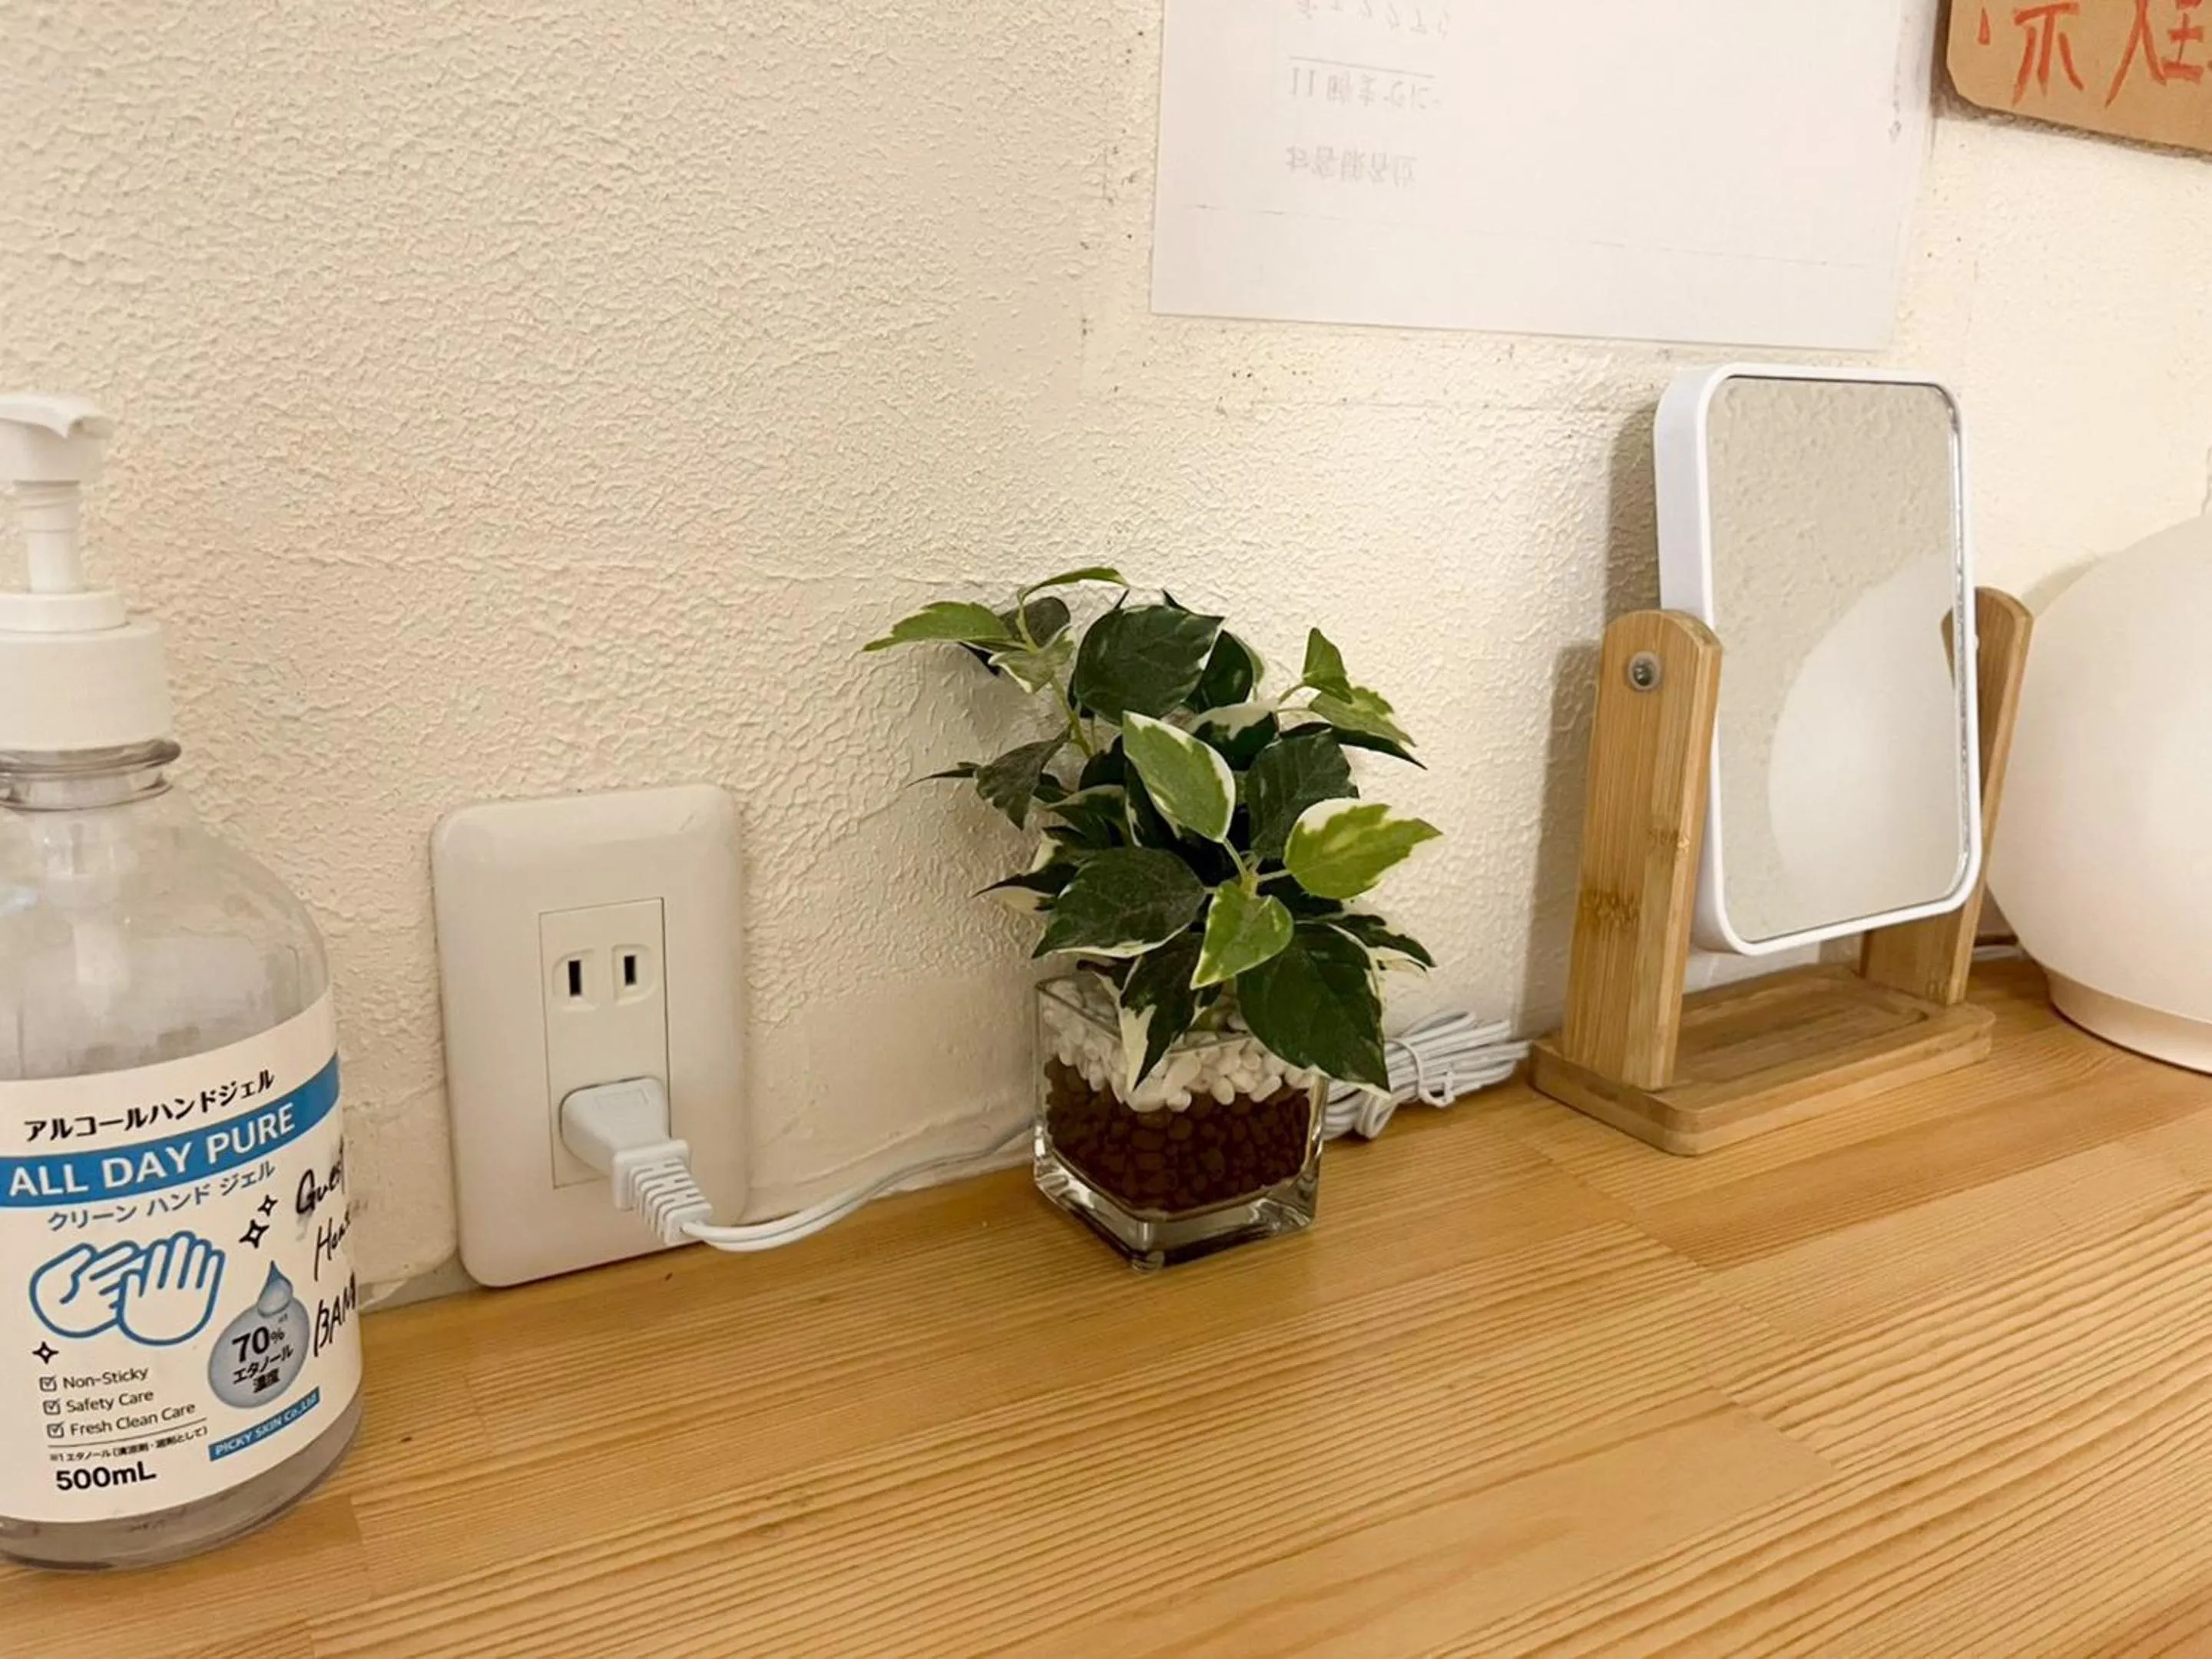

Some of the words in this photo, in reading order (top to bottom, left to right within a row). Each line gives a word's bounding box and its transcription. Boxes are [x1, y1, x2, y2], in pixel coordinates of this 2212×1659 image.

[24, 1069, 275, 1141] アルコールハンドジェル
[9, 1164, 89, 1197] ALL
[101, 1141, 193, 1189] DAY
[206, 1102, 296, 1165] PURE
[47, 1205, 137, 1231] クリーン
[147, 1183, 211, 1217] ハンド
[219, 1160, 276, 1197] ジェル
[232, 1326, 286, 1363] 70%
[63, 1367, 149, 1389] Non-Sticky
[233, 1344, 294, 1384] エタノール
[66, 1398, 114, 1413] Safety
[118, 1390, 154, 1406] Care
[70, 1419, 113, 1436] Fresh
[116, 1412, 158, 1430] Clean
[161, 1402, 196, 1420] Care
[56, 1461, 157, 1491] 500mL
